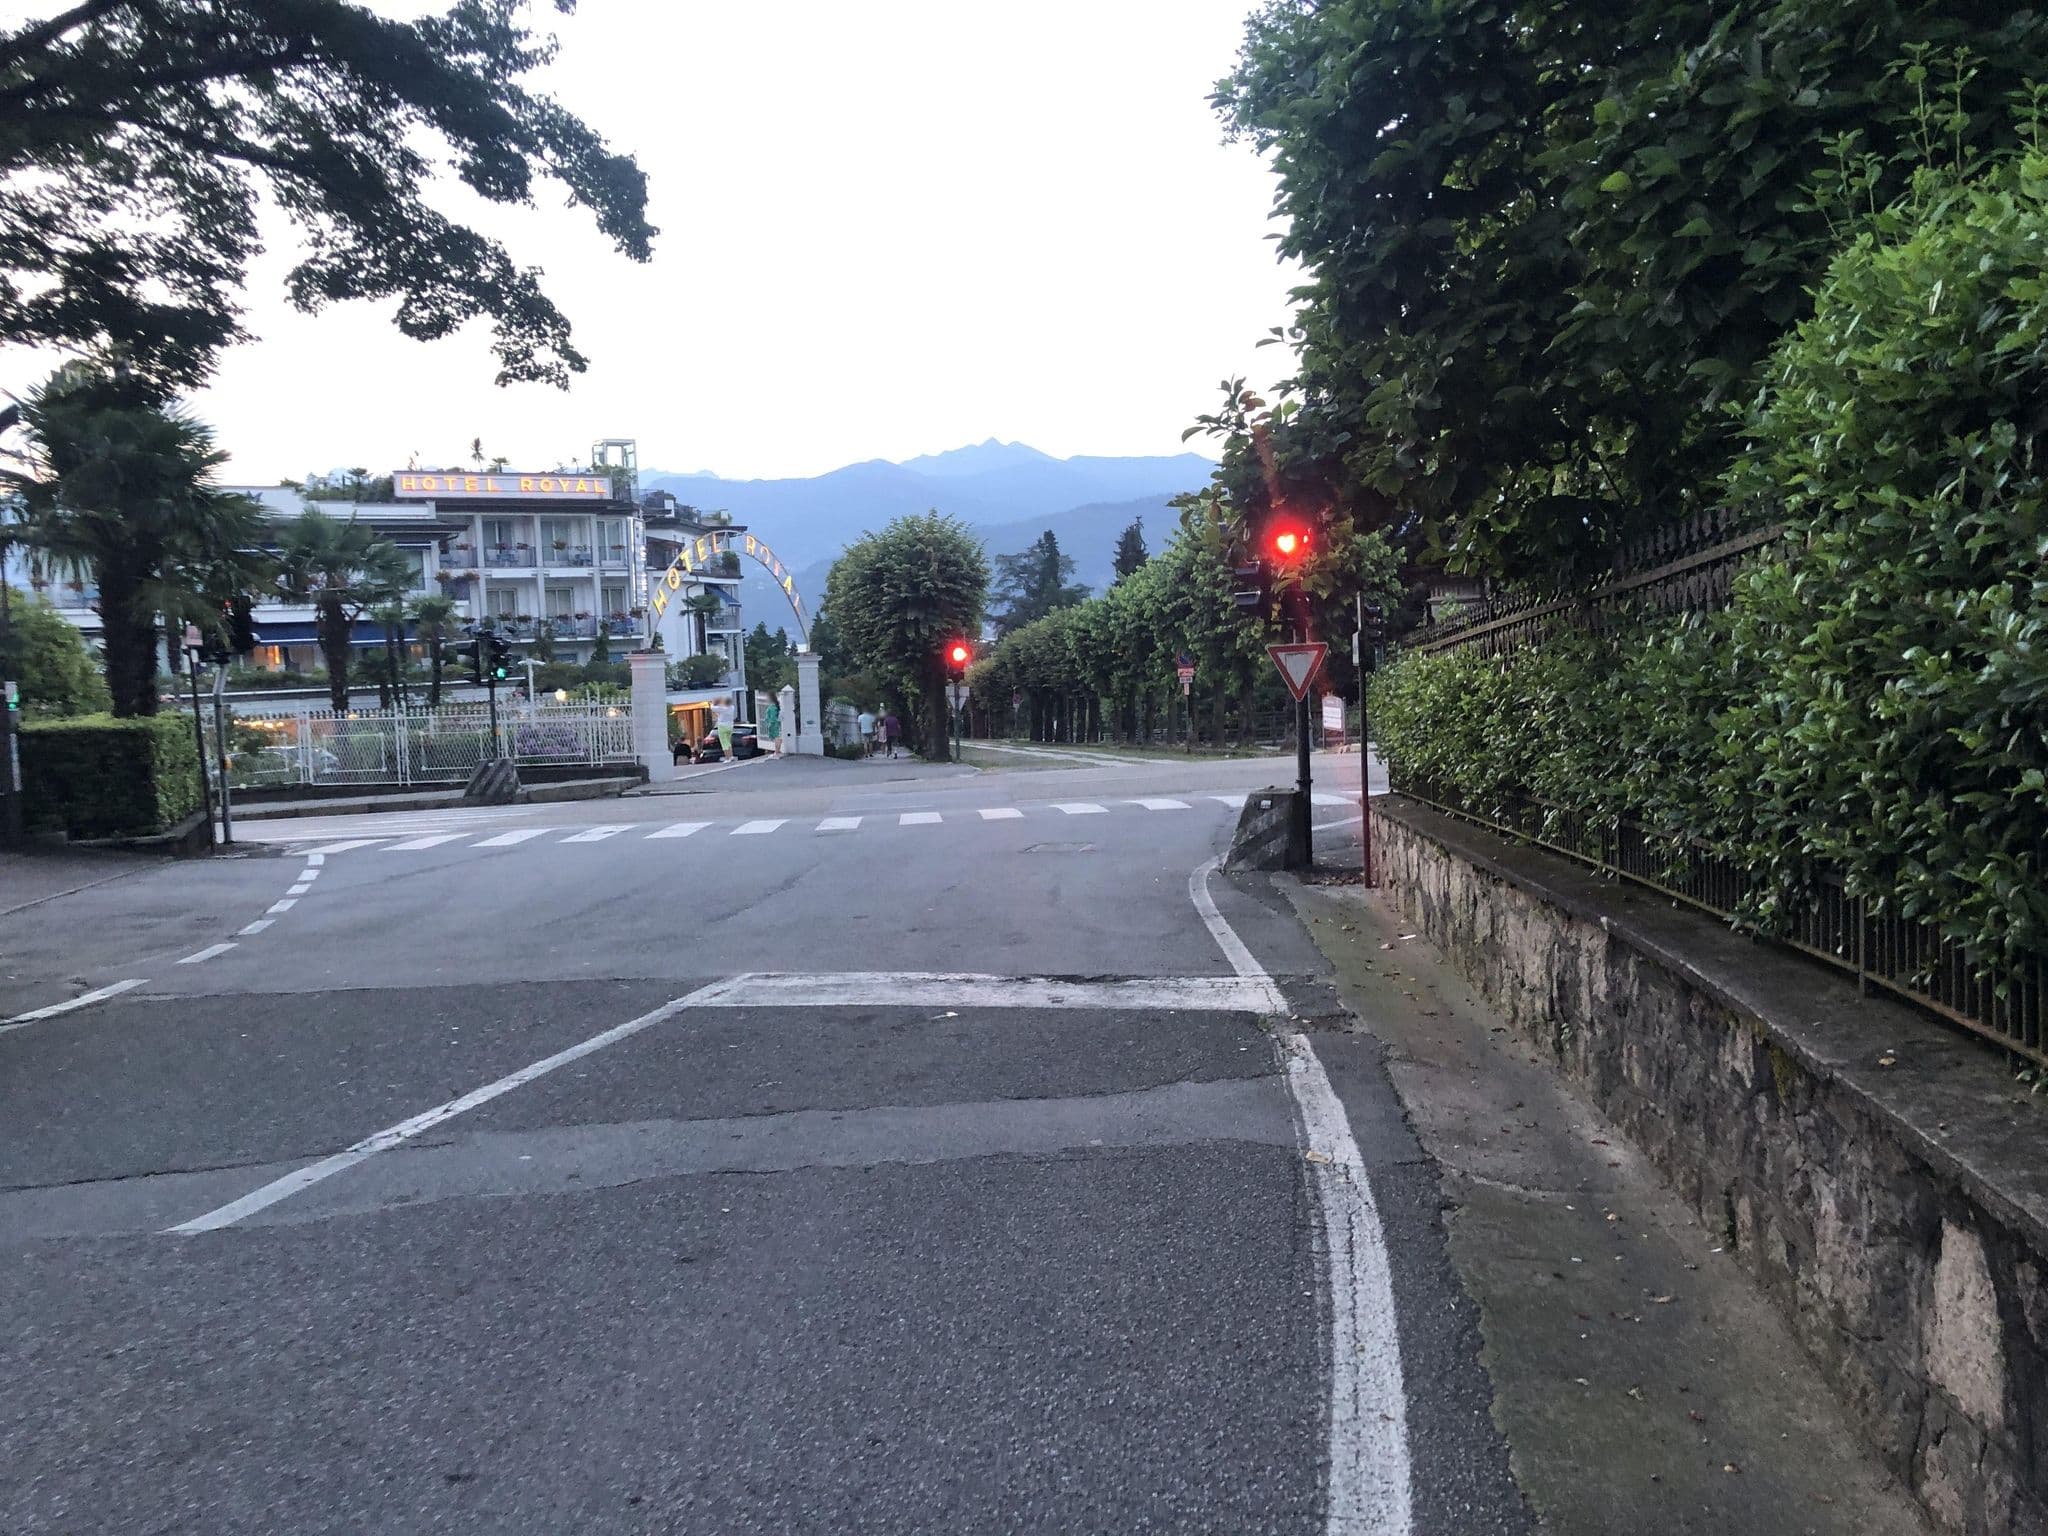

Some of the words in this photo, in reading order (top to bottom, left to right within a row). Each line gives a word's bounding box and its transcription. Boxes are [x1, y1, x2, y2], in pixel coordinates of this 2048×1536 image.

[401, 475, 500, 492] HOTEL
[519, 476, 606, 493] ROYAL
[652, 533, 721, 616] HOTEL
